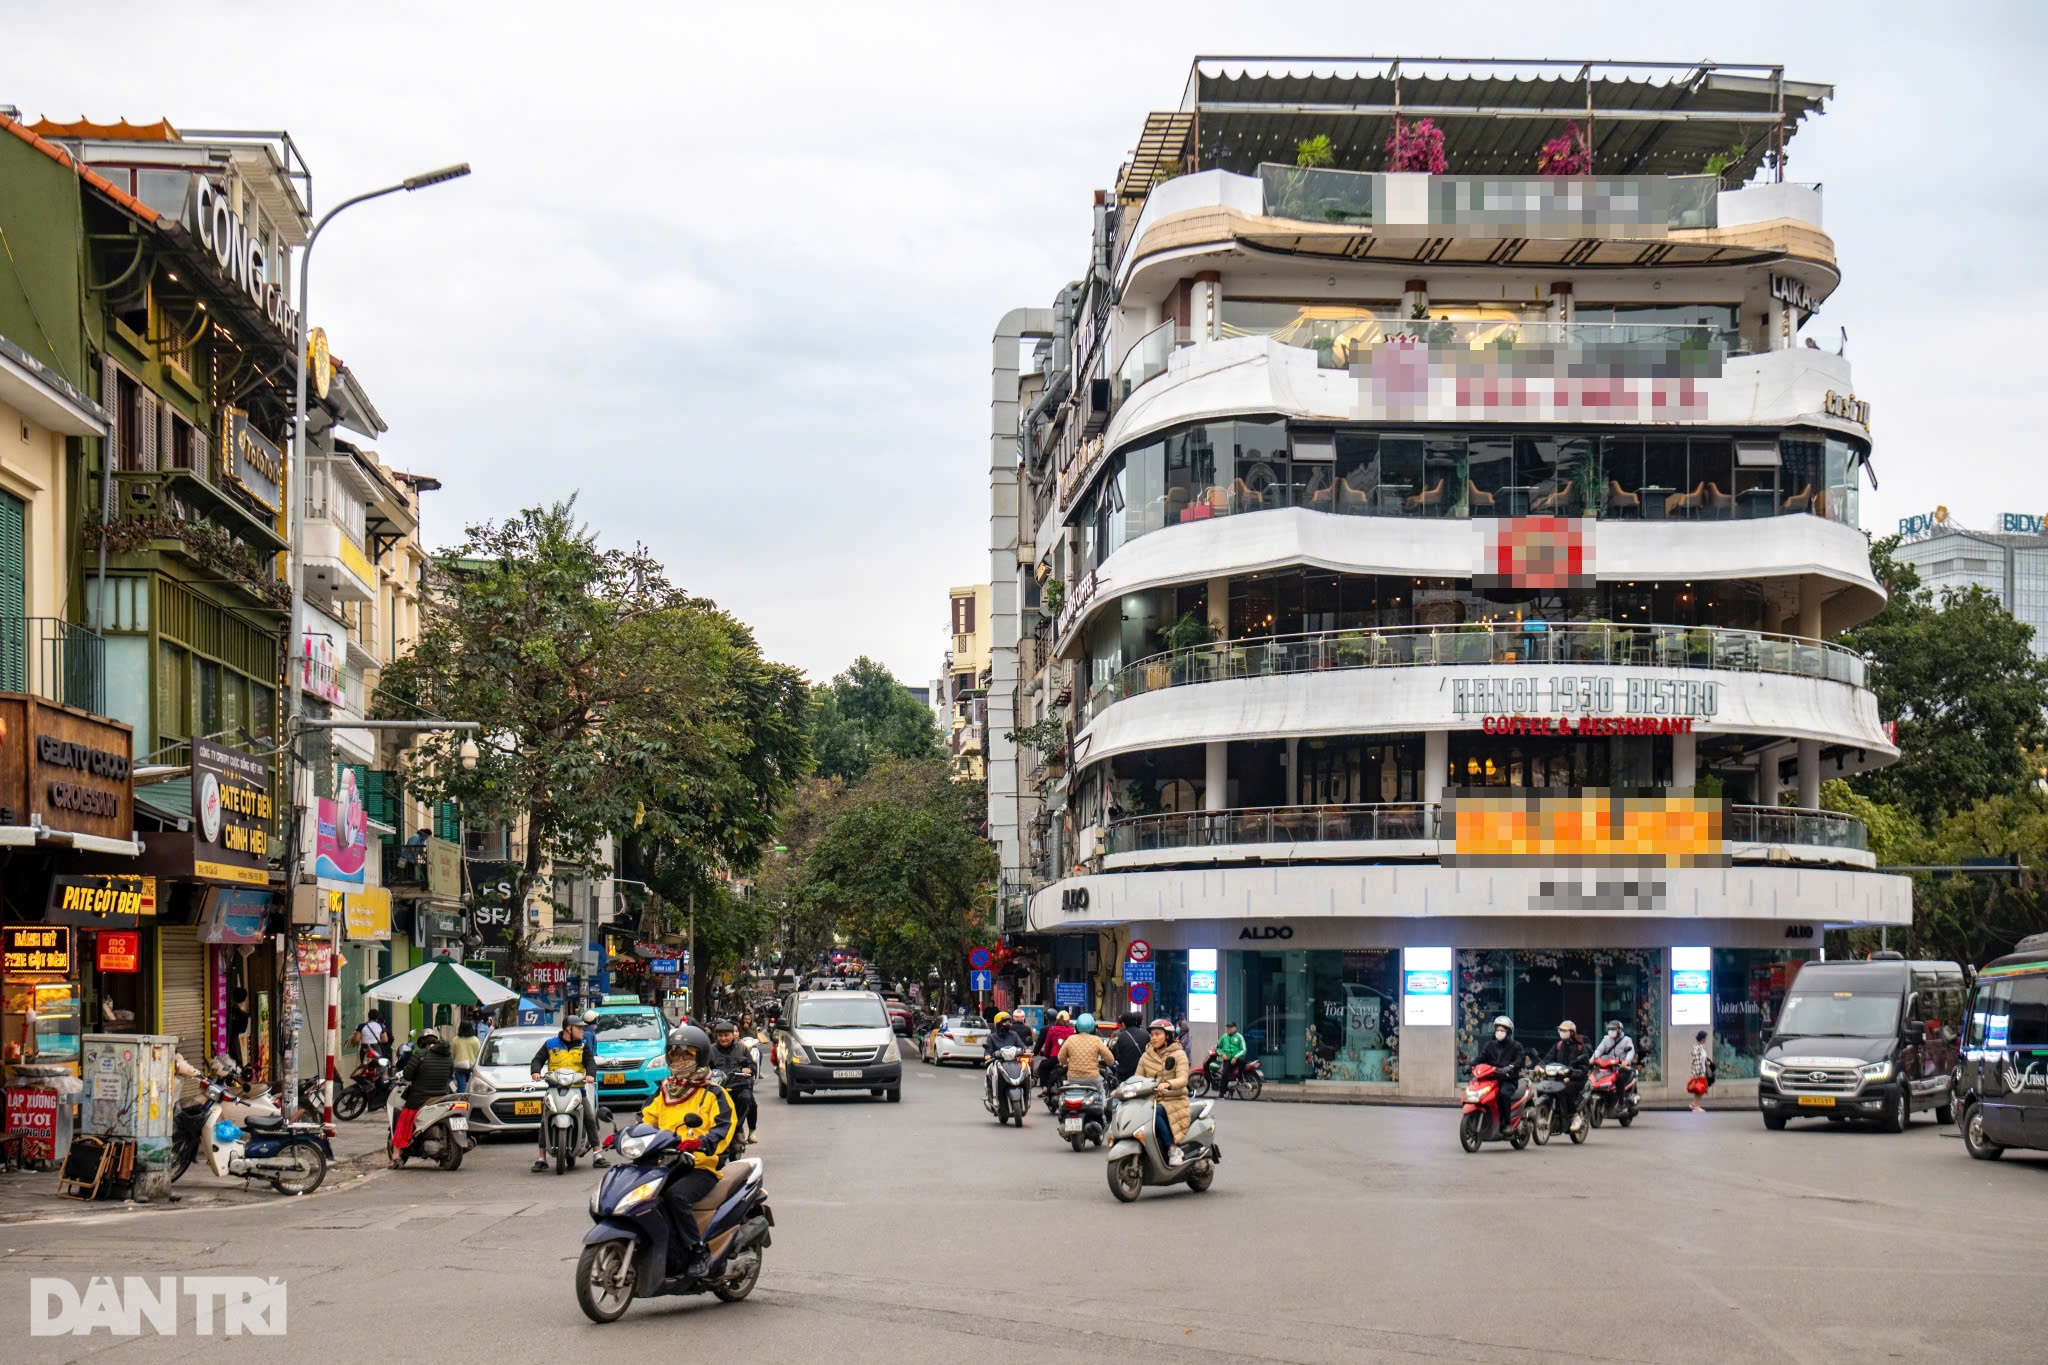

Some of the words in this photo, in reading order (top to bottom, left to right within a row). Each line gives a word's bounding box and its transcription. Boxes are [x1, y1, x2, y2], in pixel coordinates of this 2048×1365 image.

[197, 174, 264, 309] CỘNG
[266, 283, 301, 347] CÀPH
[1771, 272, 1812, 311] LAIKA
[1899, 511, 1934, 536] BIDV
[2003, 512, 2043, 534] BIDV
[1452, 677, 1539, 713] HANOI
[1550, 676, 1614, 712] 1930
[1626, 677, 1718, 715] BISTRO
[1483, 716, 1552, 736] COFFEE
[1558, 717, 1572, 735] &
[1579, 717, 1695, 736] RESTAURANT
[40, 734, 89, 770] GELATO
[91, 747, 130, 779] CHOCO
[53, 781, 119, 818] CROISSANT
[220, 783, 240, 812] PATE
[240, 783, 256, 820] CỘT
[225, 818, 249, 852] CHÍNH
[249, 824, 267, 860] HIỆU
[62, 885, 96, 912] PATE
[94, 880, 119, 919] CỘT
[117, 885, 141, 915] ĐÈN
[1238, 926, 1294, 940] ALDO
[533, 967, 552, 983] FREE
[525, 1010, 539, 1025] G7
[8, 1093, 25, 1111] LẠP
[11, 1112, 51, 1126] TƯƠI
